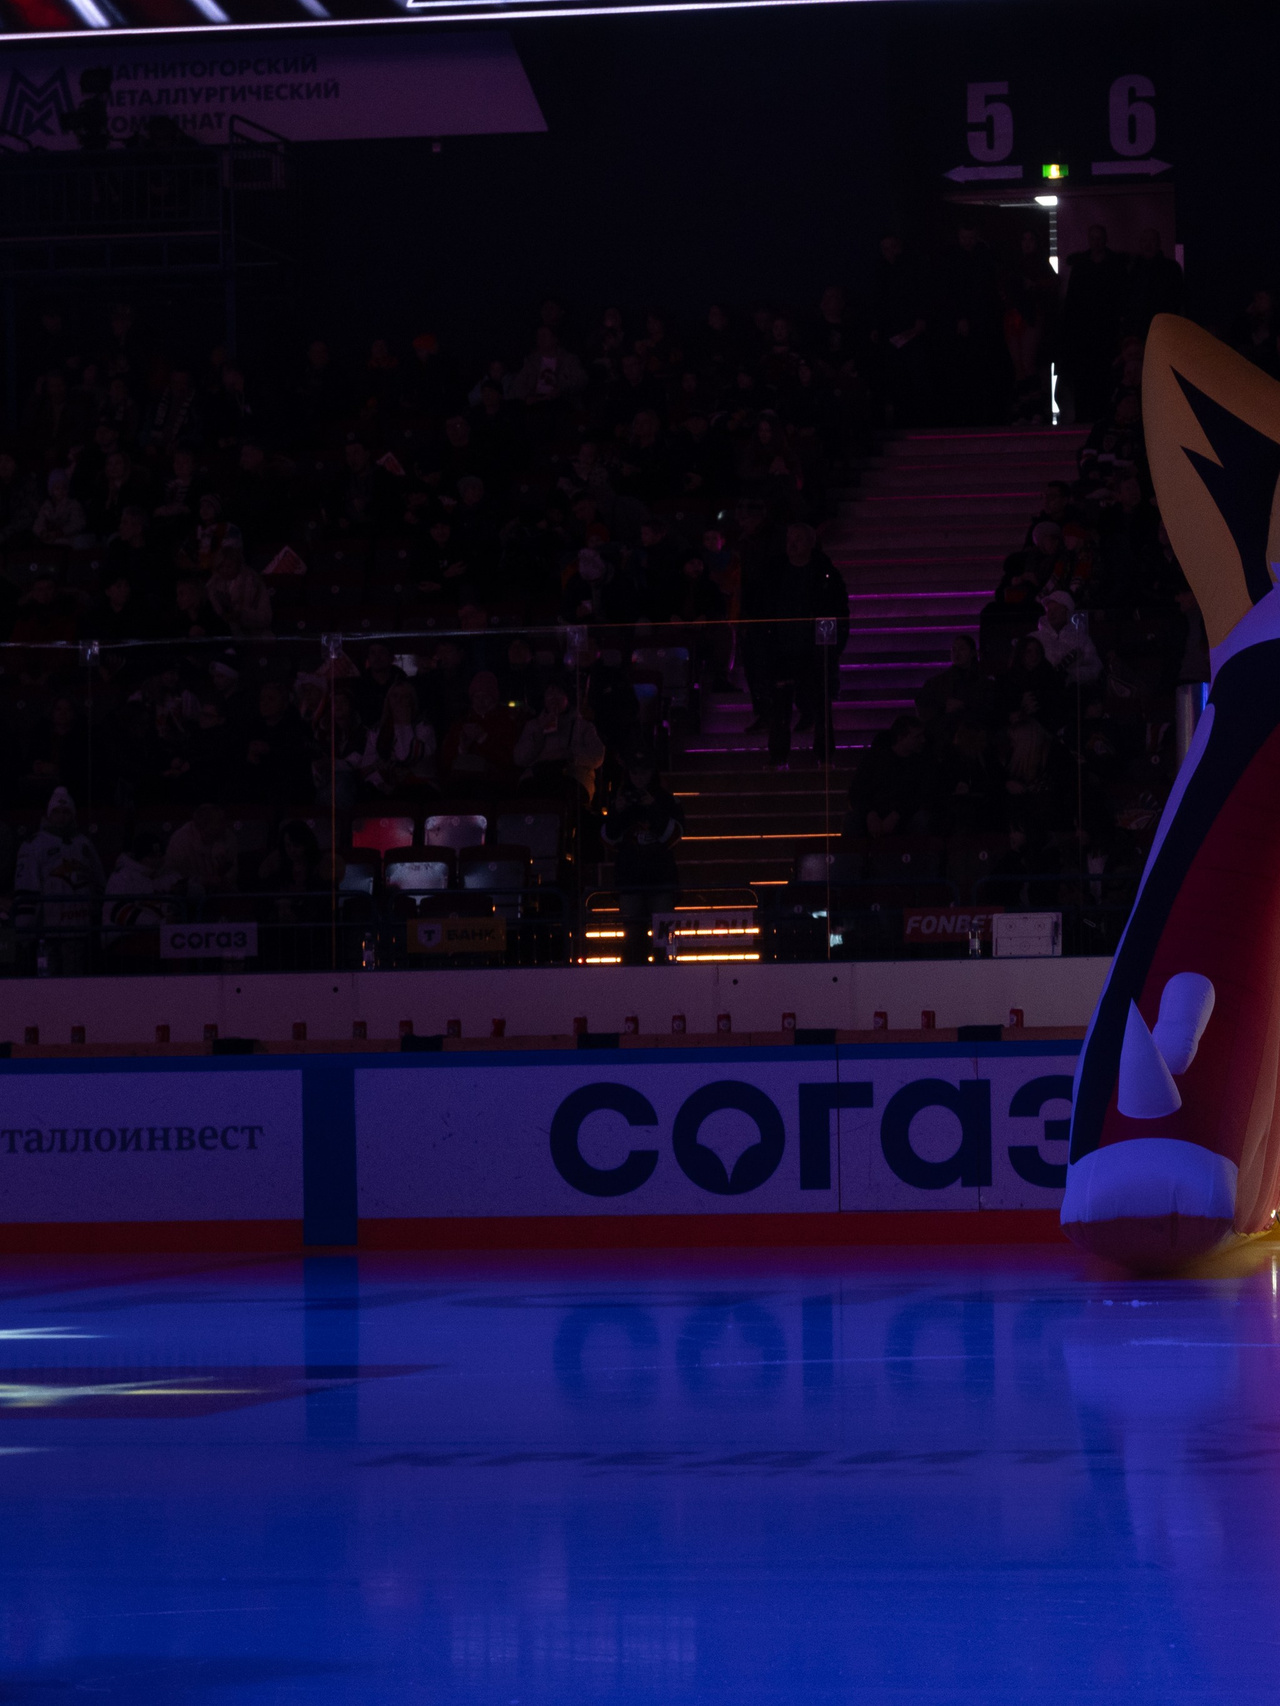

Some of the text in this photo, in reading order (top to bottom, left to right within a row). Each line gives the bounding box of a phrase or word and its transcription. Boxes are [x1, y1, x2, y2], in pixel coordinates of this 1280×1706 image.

[111, 53, 318, 80] АГНИТОГОРСКИЙ
[966, 81, 1014, 162] 5
[1108, 73, 1157, 157] 6
